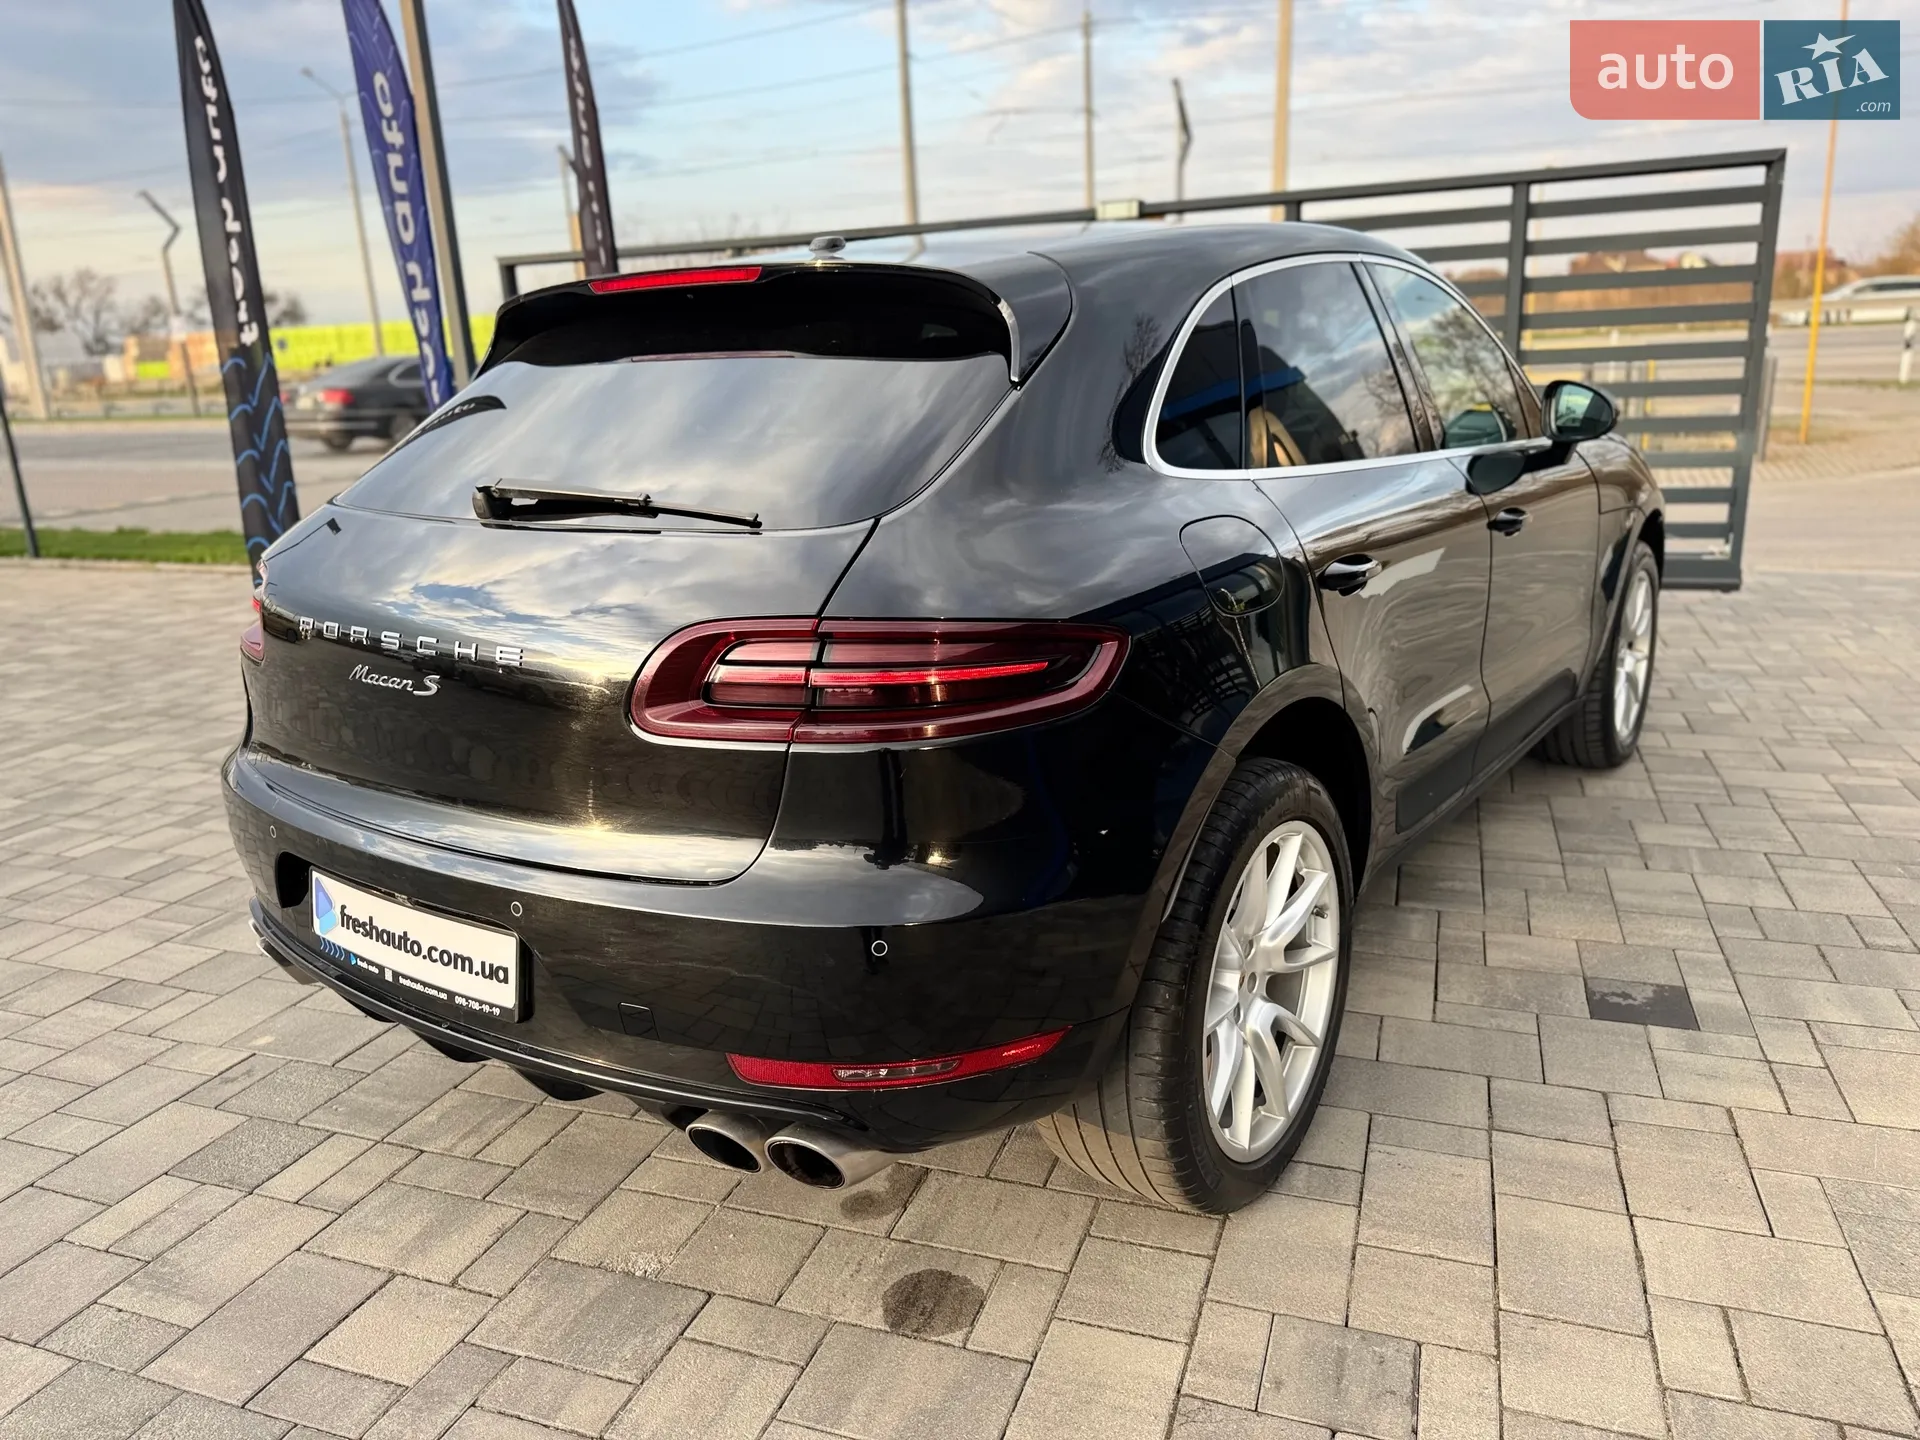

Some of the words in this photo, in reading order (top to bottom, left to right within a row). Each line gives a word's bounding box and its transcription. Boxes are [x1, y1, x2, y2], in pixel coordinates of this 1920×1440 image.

[299, 616, 525, 667] PORSCHE
[349, 663, 414, 692] Macan
[412, 674, 441, 697] S
[339, 904, 510, 985] freshauto.com.ua
